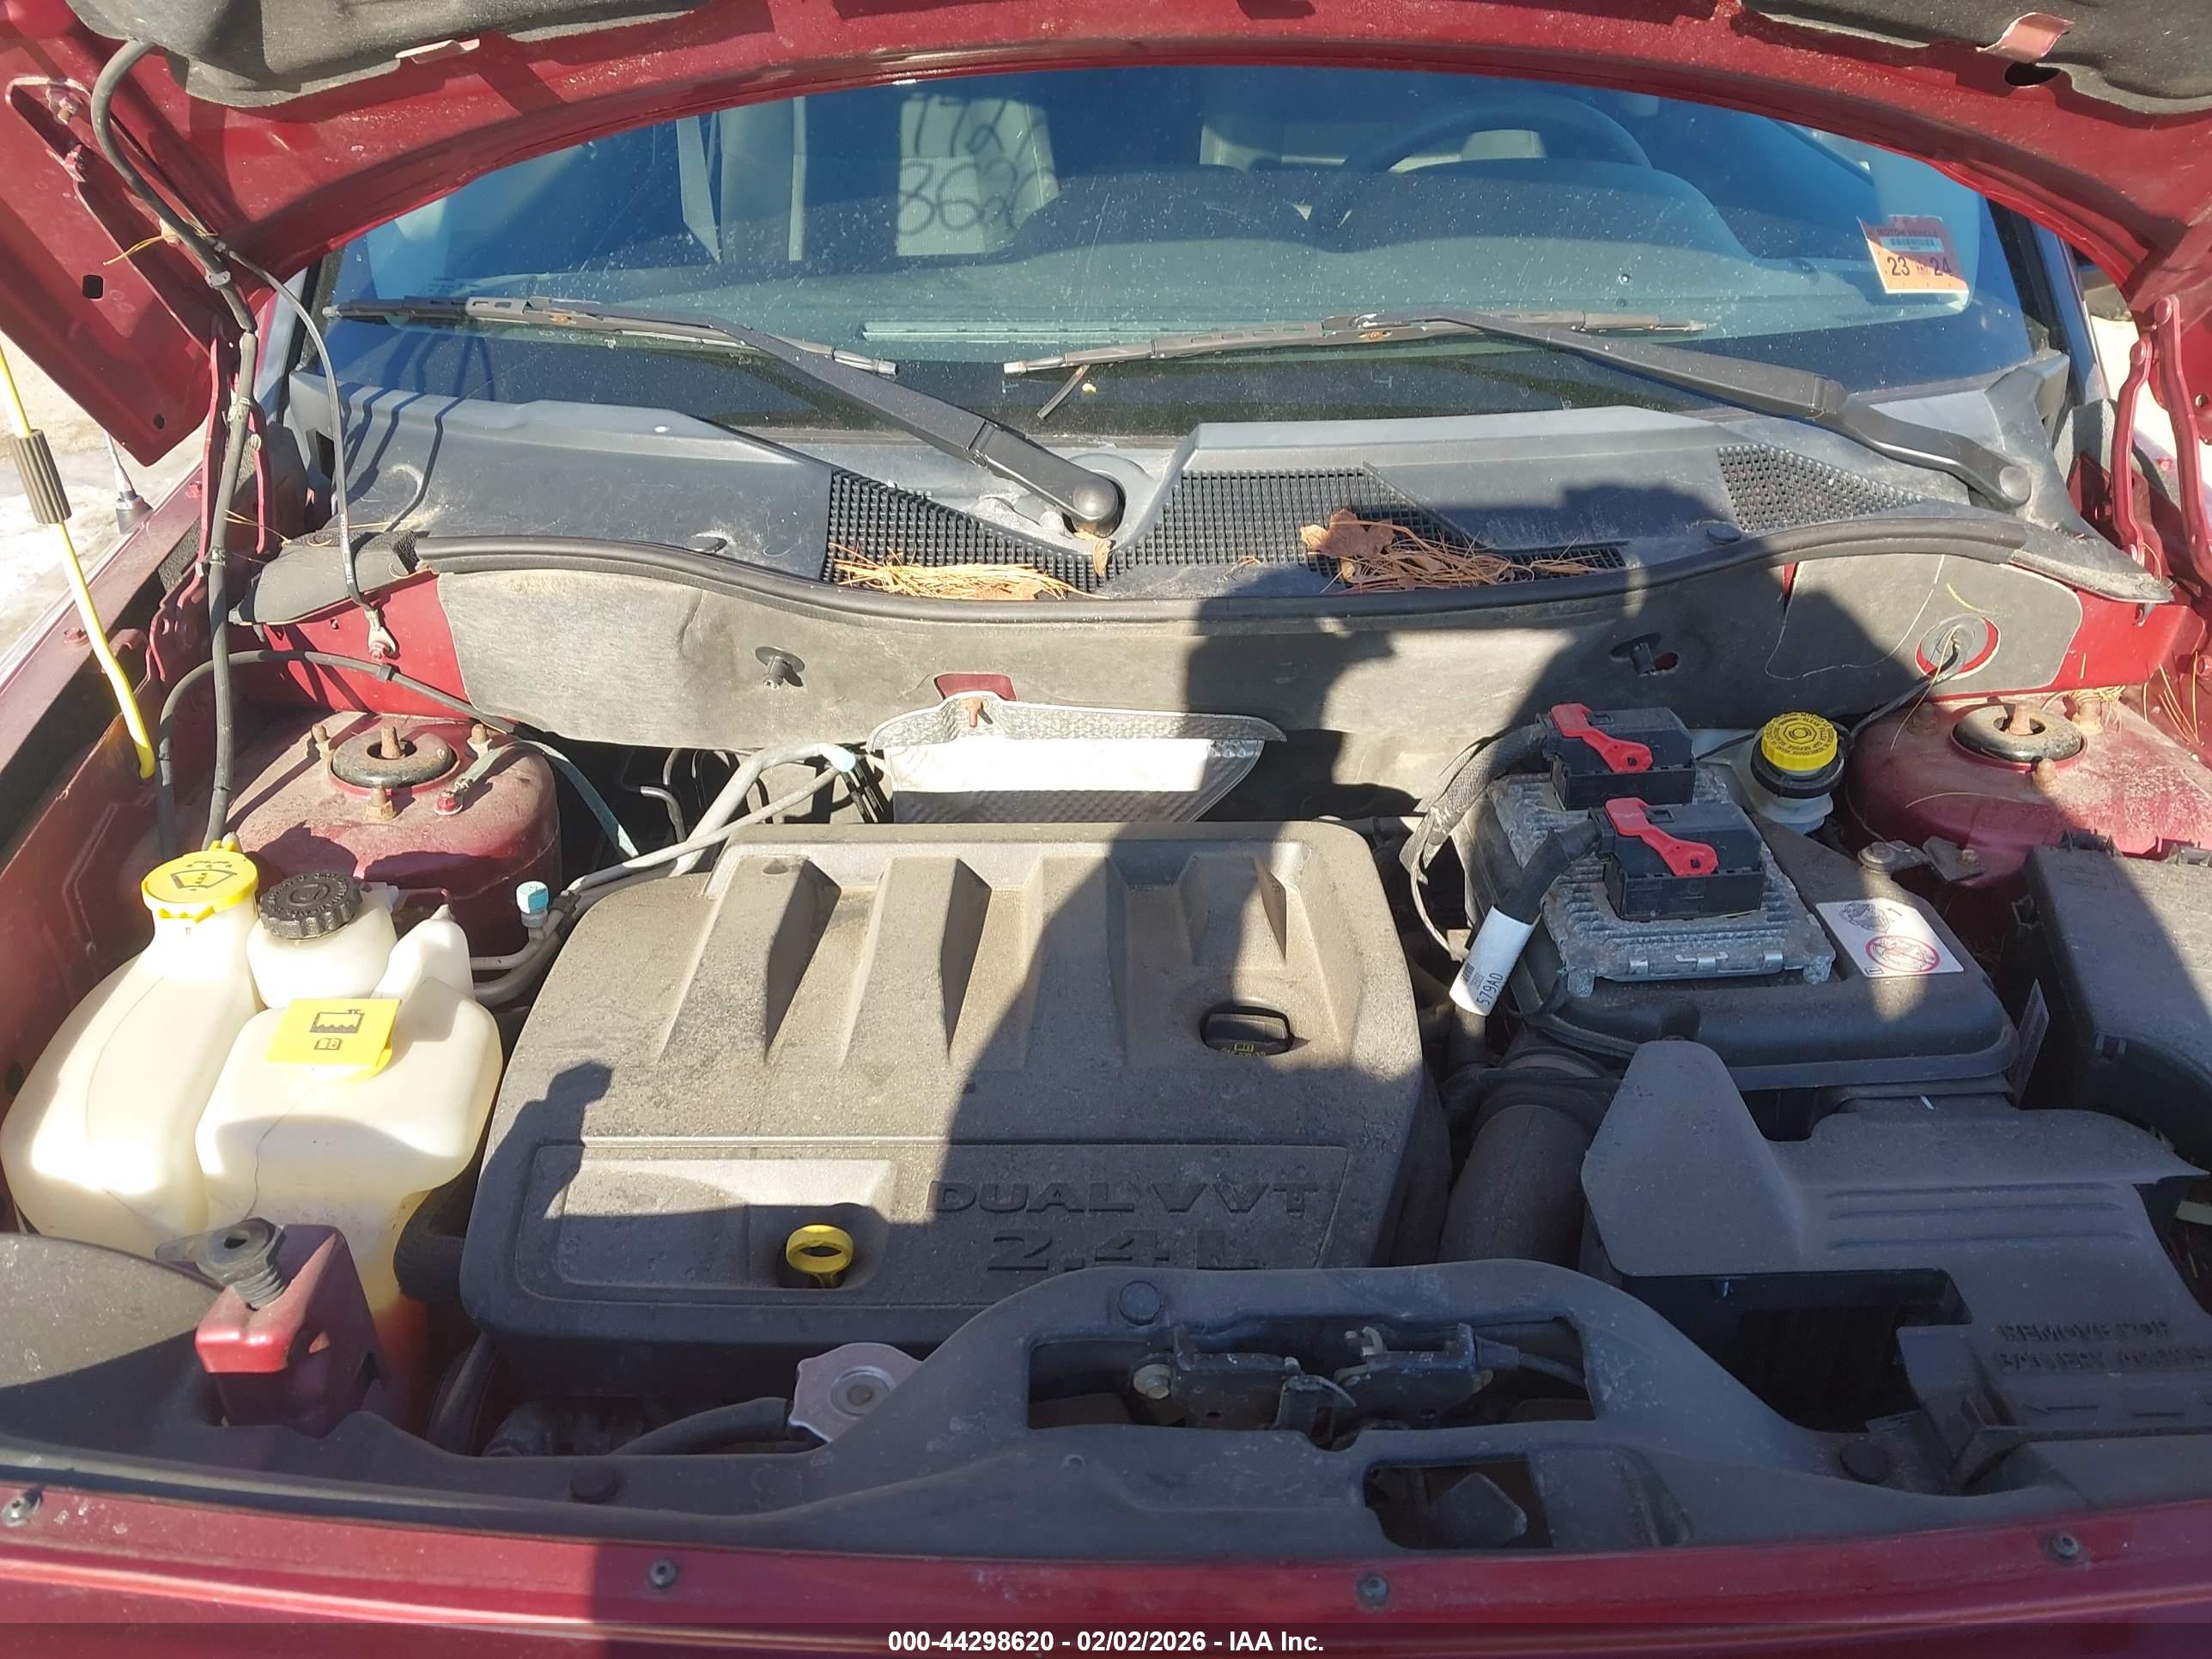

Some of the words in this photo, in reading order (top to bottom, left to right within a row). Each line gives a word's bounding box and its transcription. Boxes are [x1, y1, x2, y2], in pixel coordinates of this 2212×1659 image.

[1887, 257, 1911, 276] 23
[1929, 257, 1953, 276] 24
[1476, 972, 1504, 1006] 579AD
[926, 1180, 1134, 1214] DUAL
[1151, 1181, 1319, 1215] VVT
[1997, 1322, 2112, 1341] REMOVE
